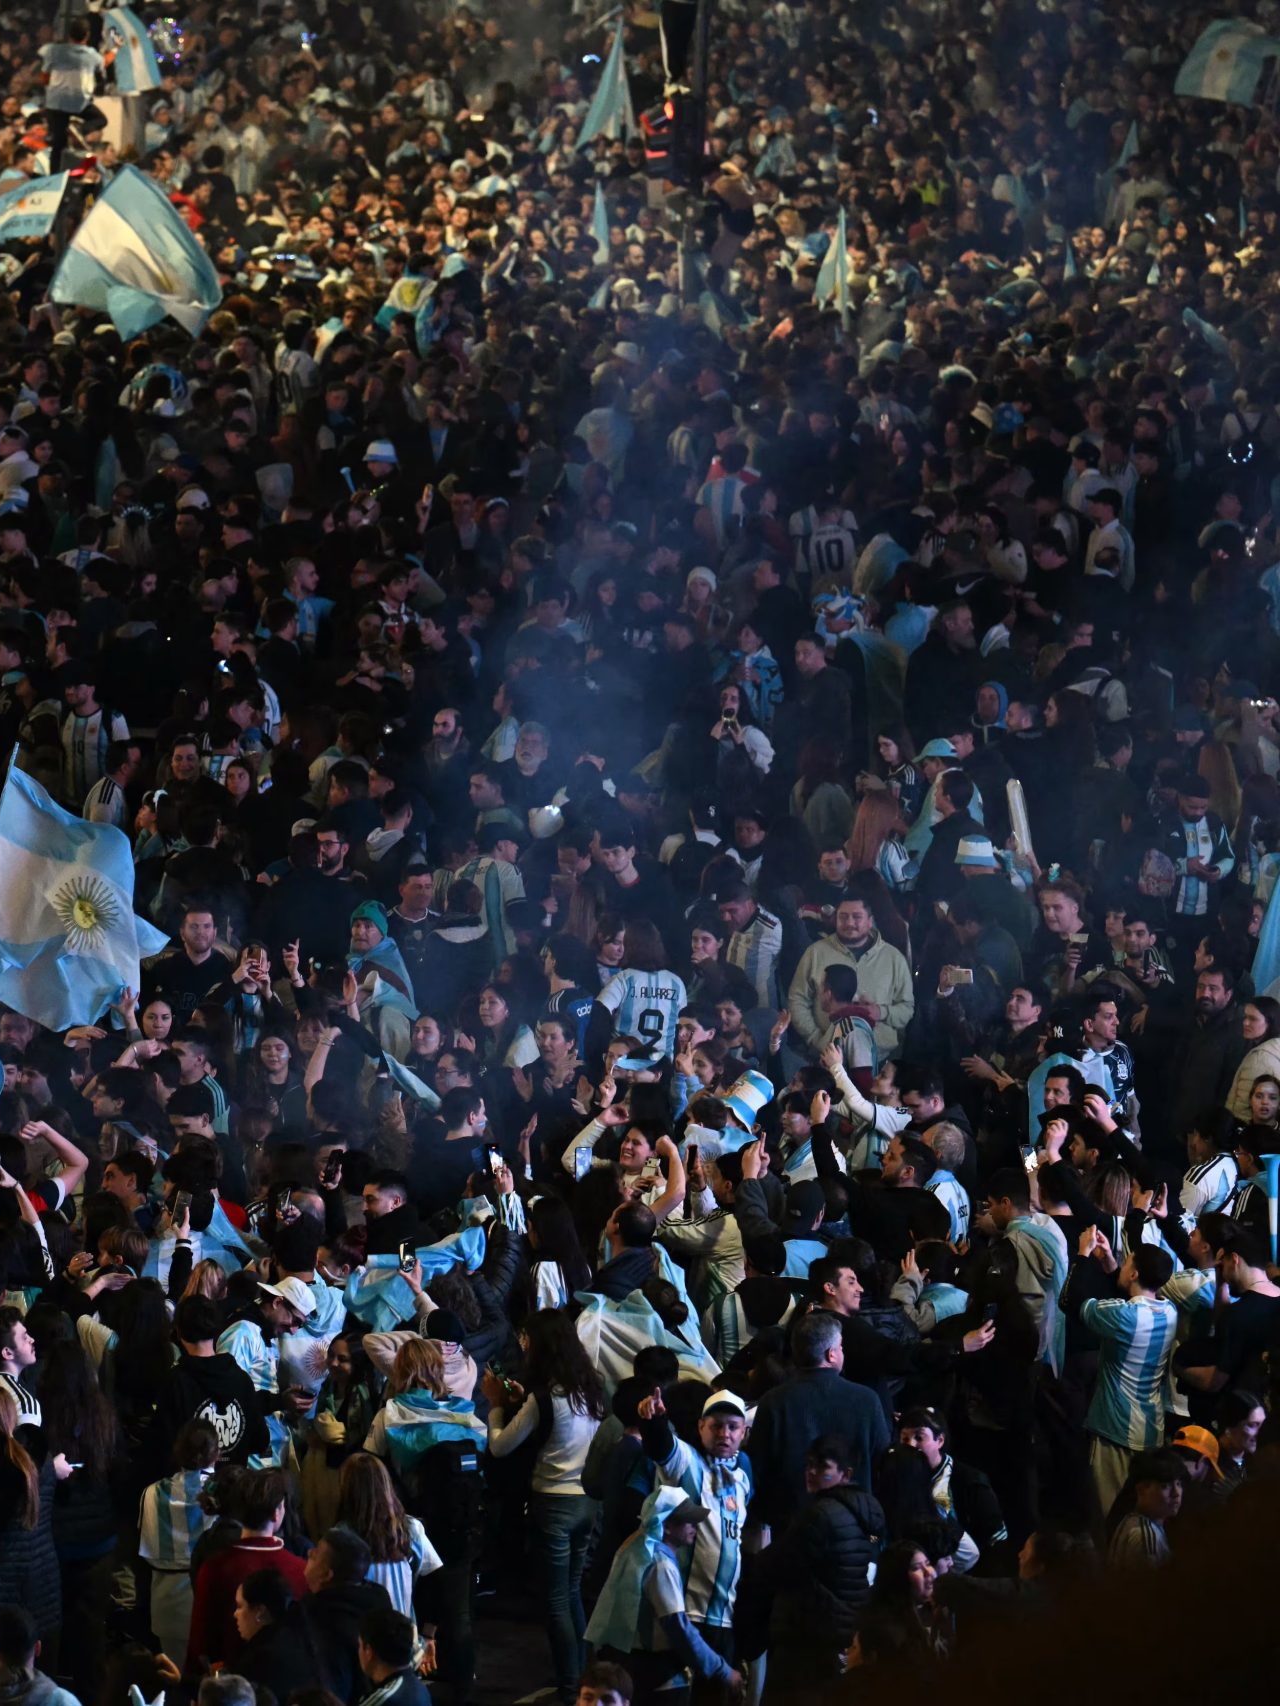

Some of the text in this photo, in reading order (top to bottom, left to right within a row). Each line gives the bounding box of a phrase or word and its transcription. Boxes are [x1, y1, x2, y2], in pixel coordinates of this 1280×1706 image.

[816, 538, 843, 574] 10
[630, 986, 638, 998] J.
[638, 1008, 665, 1048] 9
